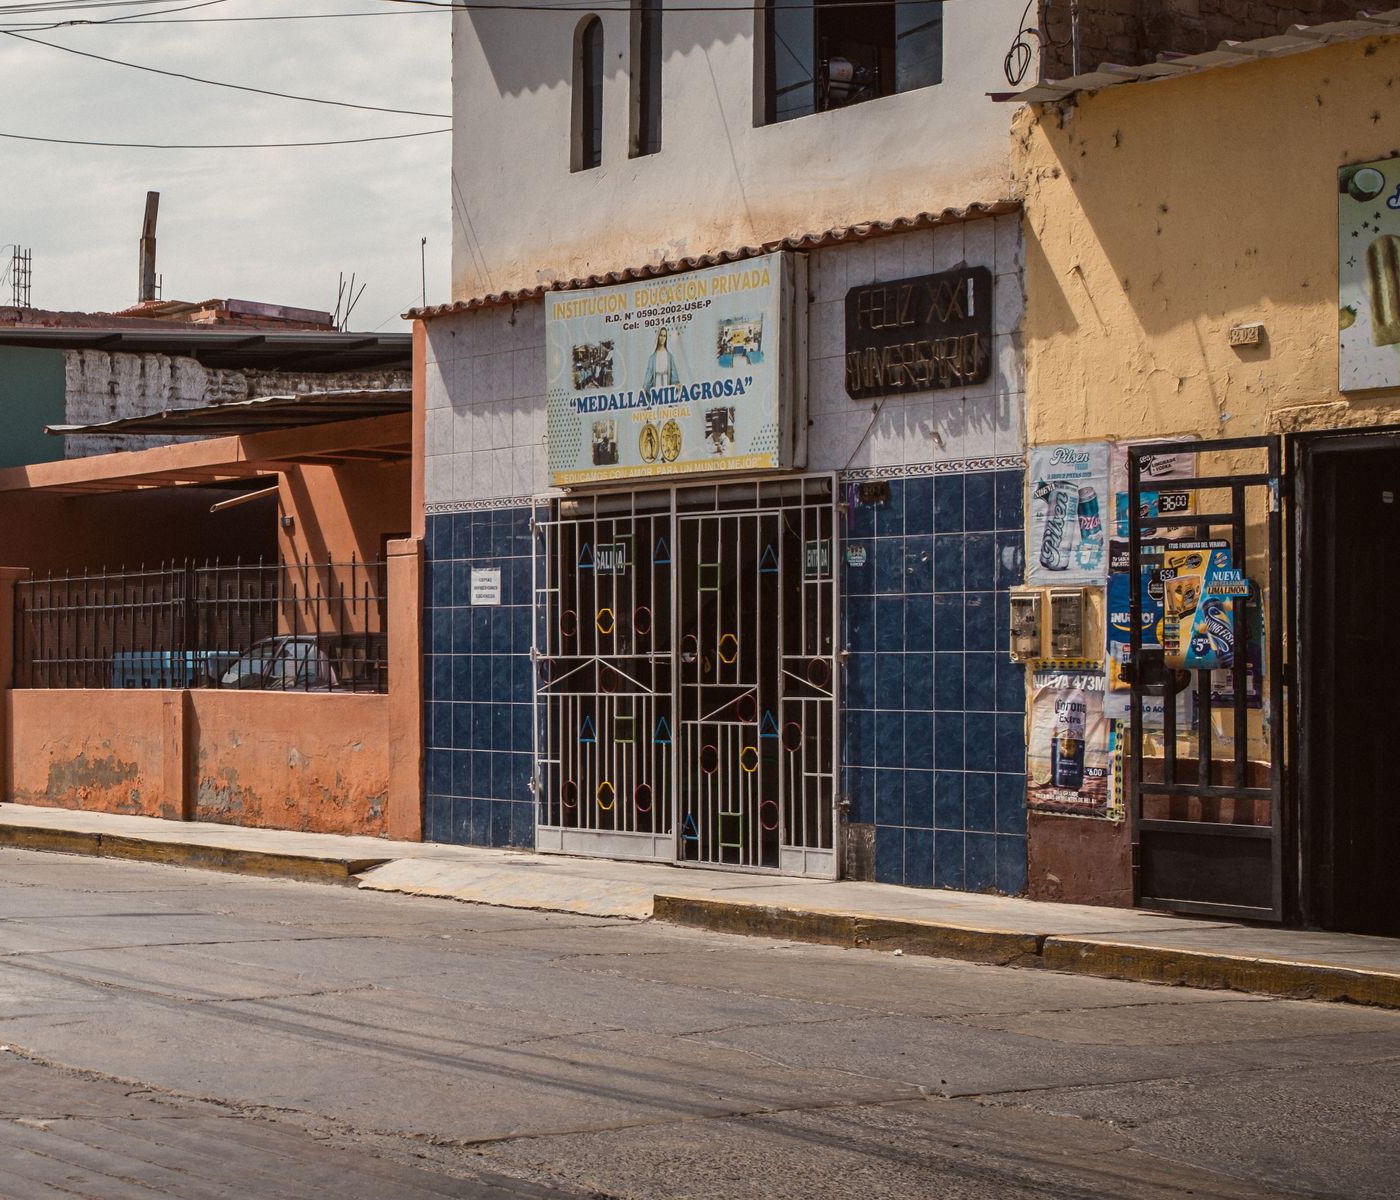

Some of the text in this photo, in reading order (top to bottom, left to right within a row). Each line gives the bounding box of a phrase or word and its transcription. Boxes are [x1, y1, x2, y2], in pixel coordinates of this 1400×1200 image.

[712, 267, 771, 296] PRIVADA
[605, 313, 622, 323] R.D.
[637, 300, 712, 318] 0590.2002-USE-P
[858, 285, 915, 330] FELIZ
[623, 314, 692, 331] Cel: 903141159
[1231, 327, 1257, 343] 202
[632, 405, 692, 422] NIVEL INICIAL
[1050, 448, 1090, 466] Pilsen
[609, 469, 626, 480] CON
[656, 466, 678, 476] PARA
[680, 465, 693, 474] UN
[694, 461, 726, 473] MUNDO
[1034, 483, 1056, 499] NUEVA
[1040, 491, 1069, 566] Pilsen
[596, 550, 623, 569] SALIA
[1212, 571, 1241, 581] NUEVA
[1032, 674, 1069, 690] NUEVA
[1055, 698, 1086, 714] Corona
[1059, 713, 1081, 724] Extra
